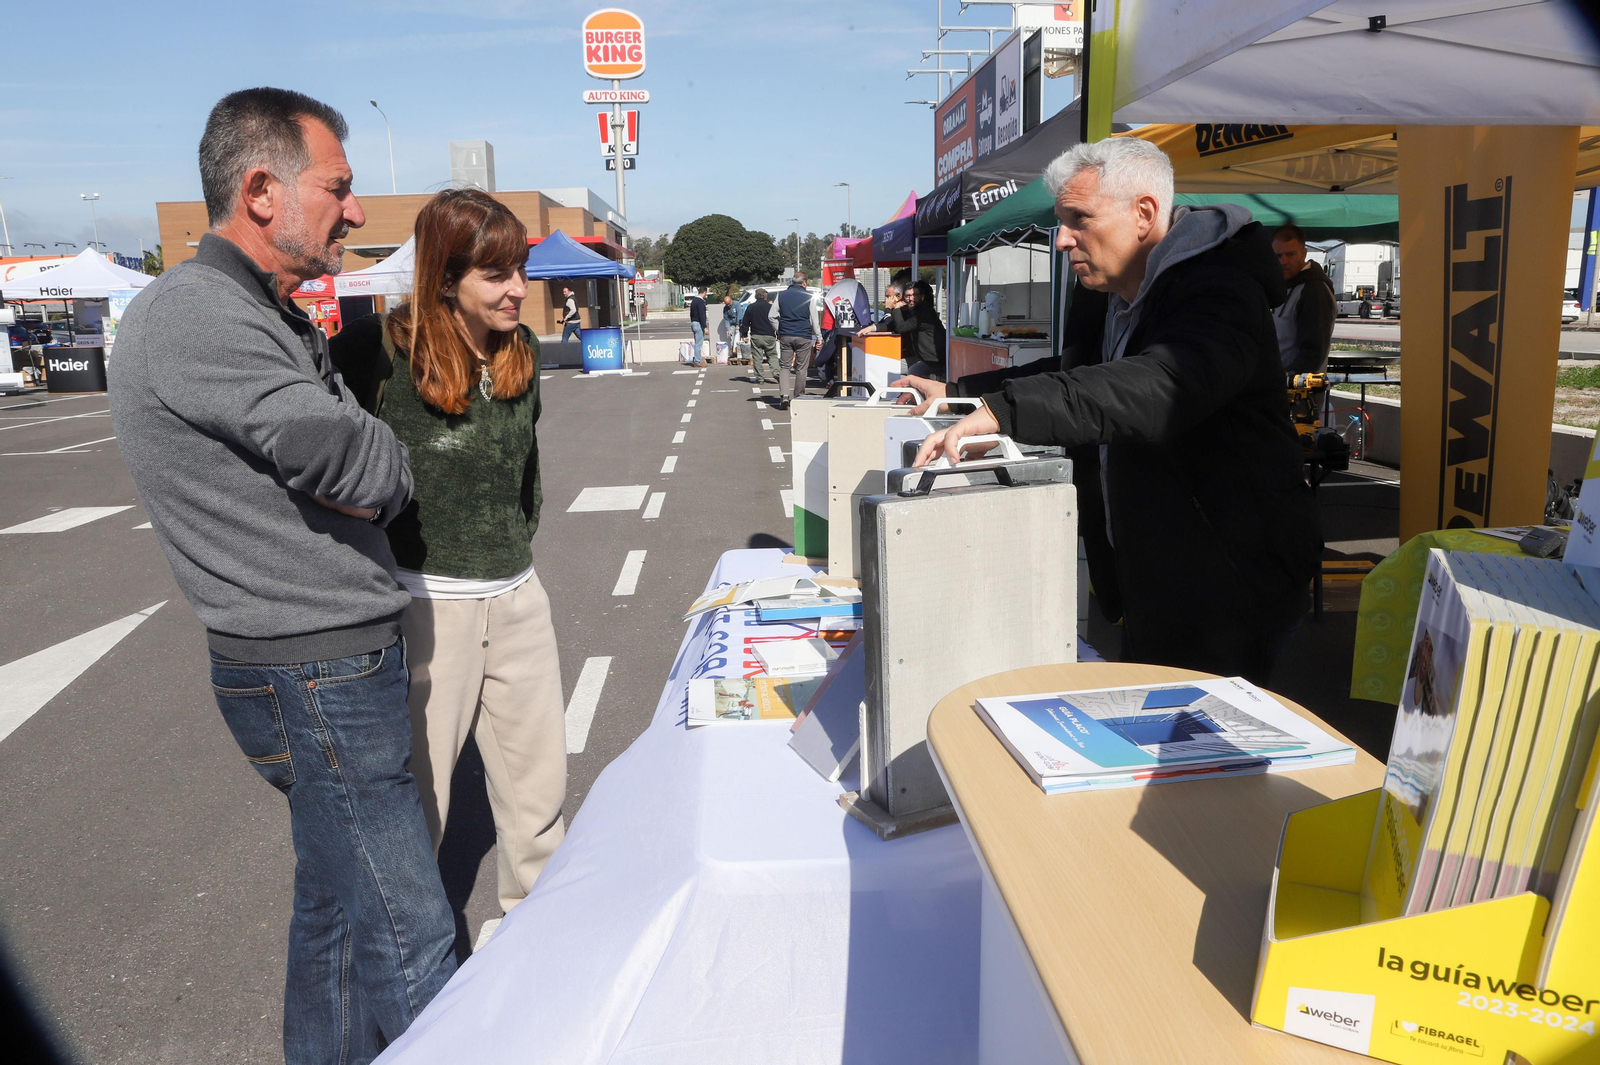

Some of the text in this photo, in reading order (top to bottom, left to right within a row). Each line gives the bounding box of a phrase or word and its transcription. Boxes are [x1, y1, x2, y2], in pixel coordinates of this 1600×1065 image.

[585, 31, 642, 44] BURGER
[1024, 26, 1071, 35] PAONES
[586, 44, 643, 63] KING
[588, 91, 645, 101] AUTO KING
[943, 102, 967, 136] OBRAMAT
[997, 117, 1018, 146] Recogida
[607, 143, 632, 154] KC
[978, 134, 992, 157] Entrega
[609, 159, 631, 170] AO
[937, 136, 974, 178] COMPRA
[971, 179, 1019, 211] Ferroli
[39, 286, 73, 296] Haier
[348, 280, 371, 288] BOSCH
[587, 344, 614, 359] Solera
[49, 358, 89, 372] Haier
[1059, 706, 1089, 734] GUÍA PLACO
[1377, 947, 1600, 1014] la guía weber
[1309, 1006, 1360, 1027] weber
[1456, 991, 1596, 1037] 2023-2024
[1417, 1025, 1480, 1048] FIBRAGEL
[1447, 1045, 1464, 1055] fibra
